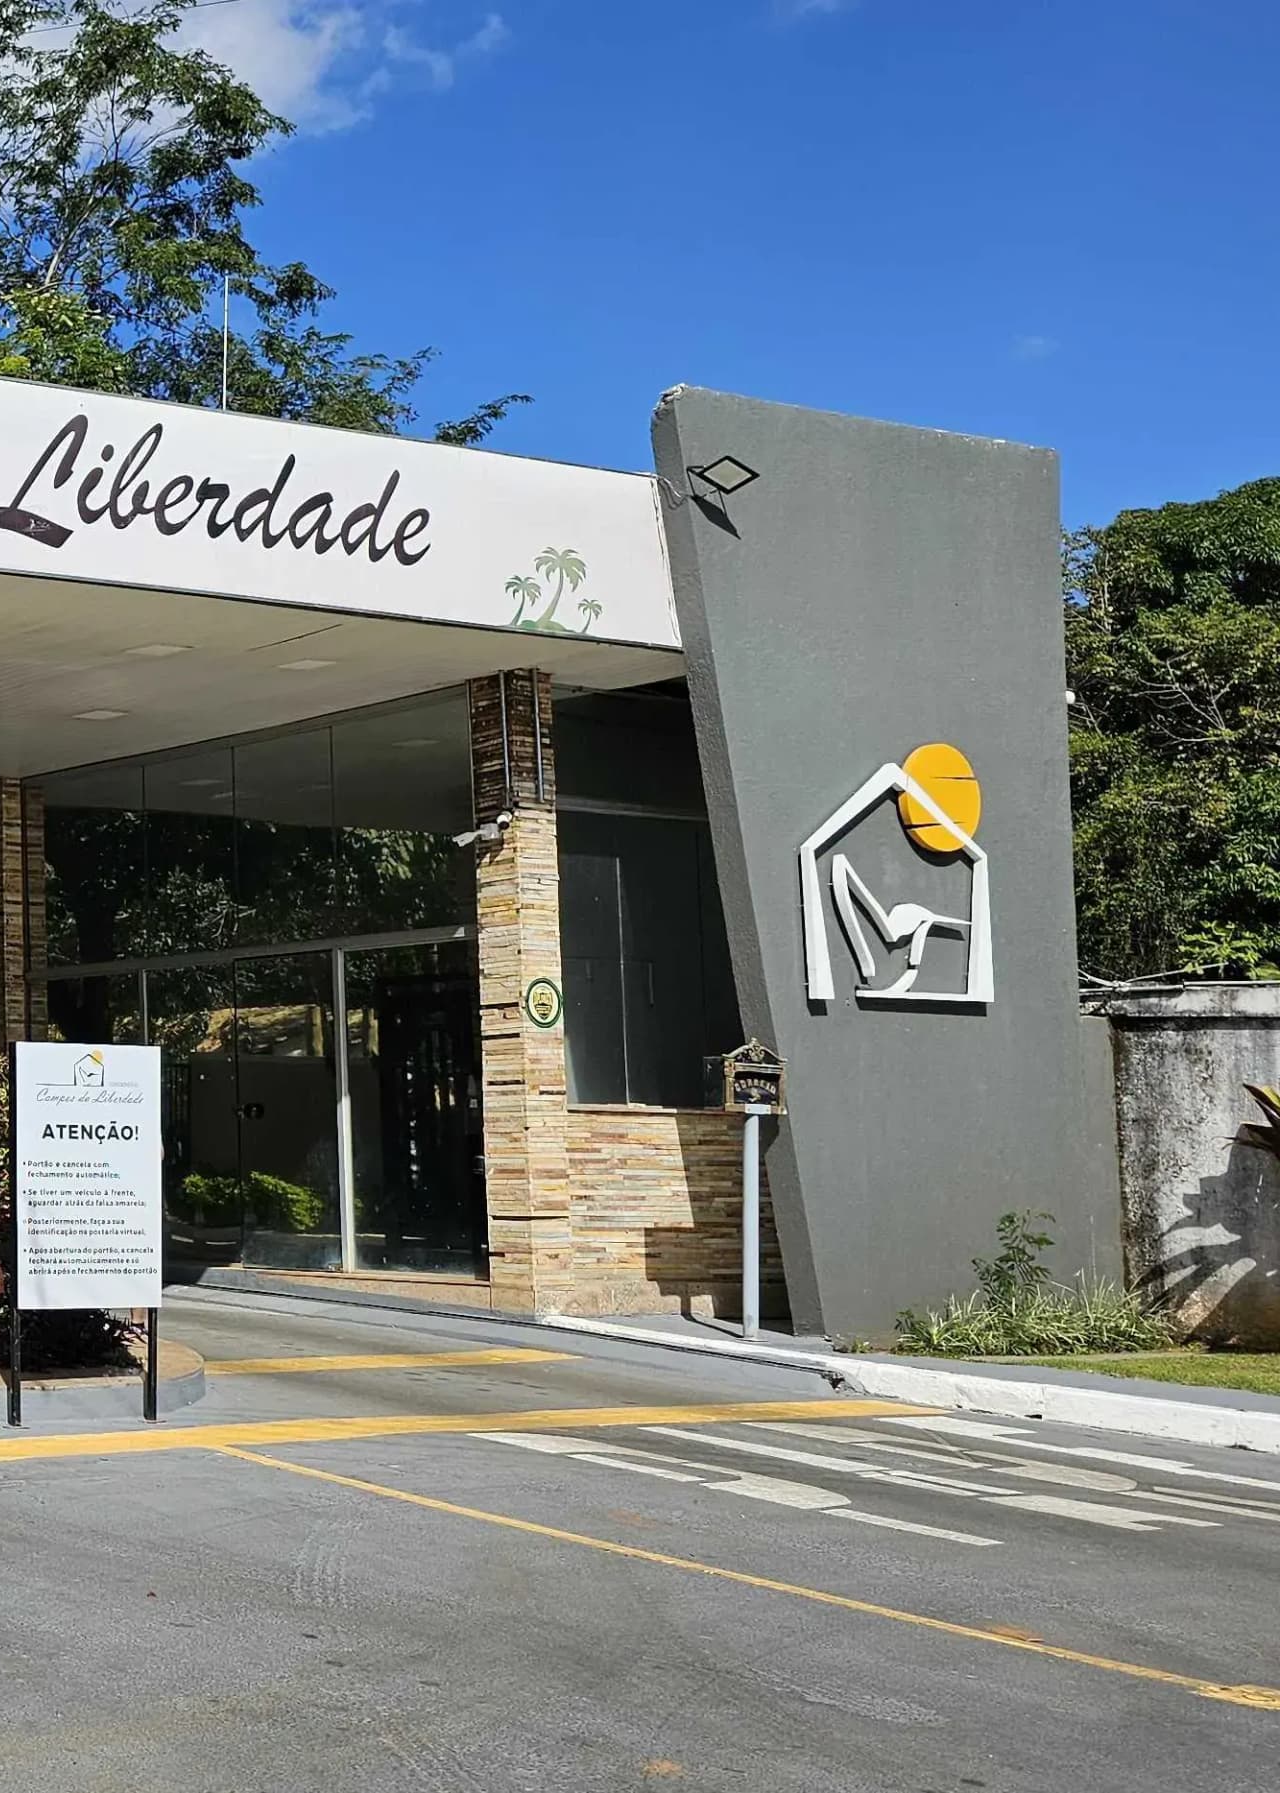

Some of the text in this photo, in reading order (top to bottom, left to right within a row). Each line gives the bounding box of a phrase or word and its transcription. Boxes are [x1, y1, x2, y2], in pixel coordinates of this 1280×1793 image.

[42, 1121, 139, 1145] ATENÇÃO!
[27, 1160, 53, 1168] Portão
[62, 1160, 92, 1168] cancela
[111, 1189, 136, 1198] frente,
[28, 1200, 63, 1208] aguardar
[85, 1199, 94, 1207] da
[90, 1218, 106, 1226] faça
[27, 1228, 78, 1236] identificação
[28, 1247, 48, 1255] Após
[28, 1257, 57, 1265] fechará
[52, 1267, 71, 1276] após
[77, 1267, 121, 1275] fechamento
[122, 1267, 133, 1275] do
